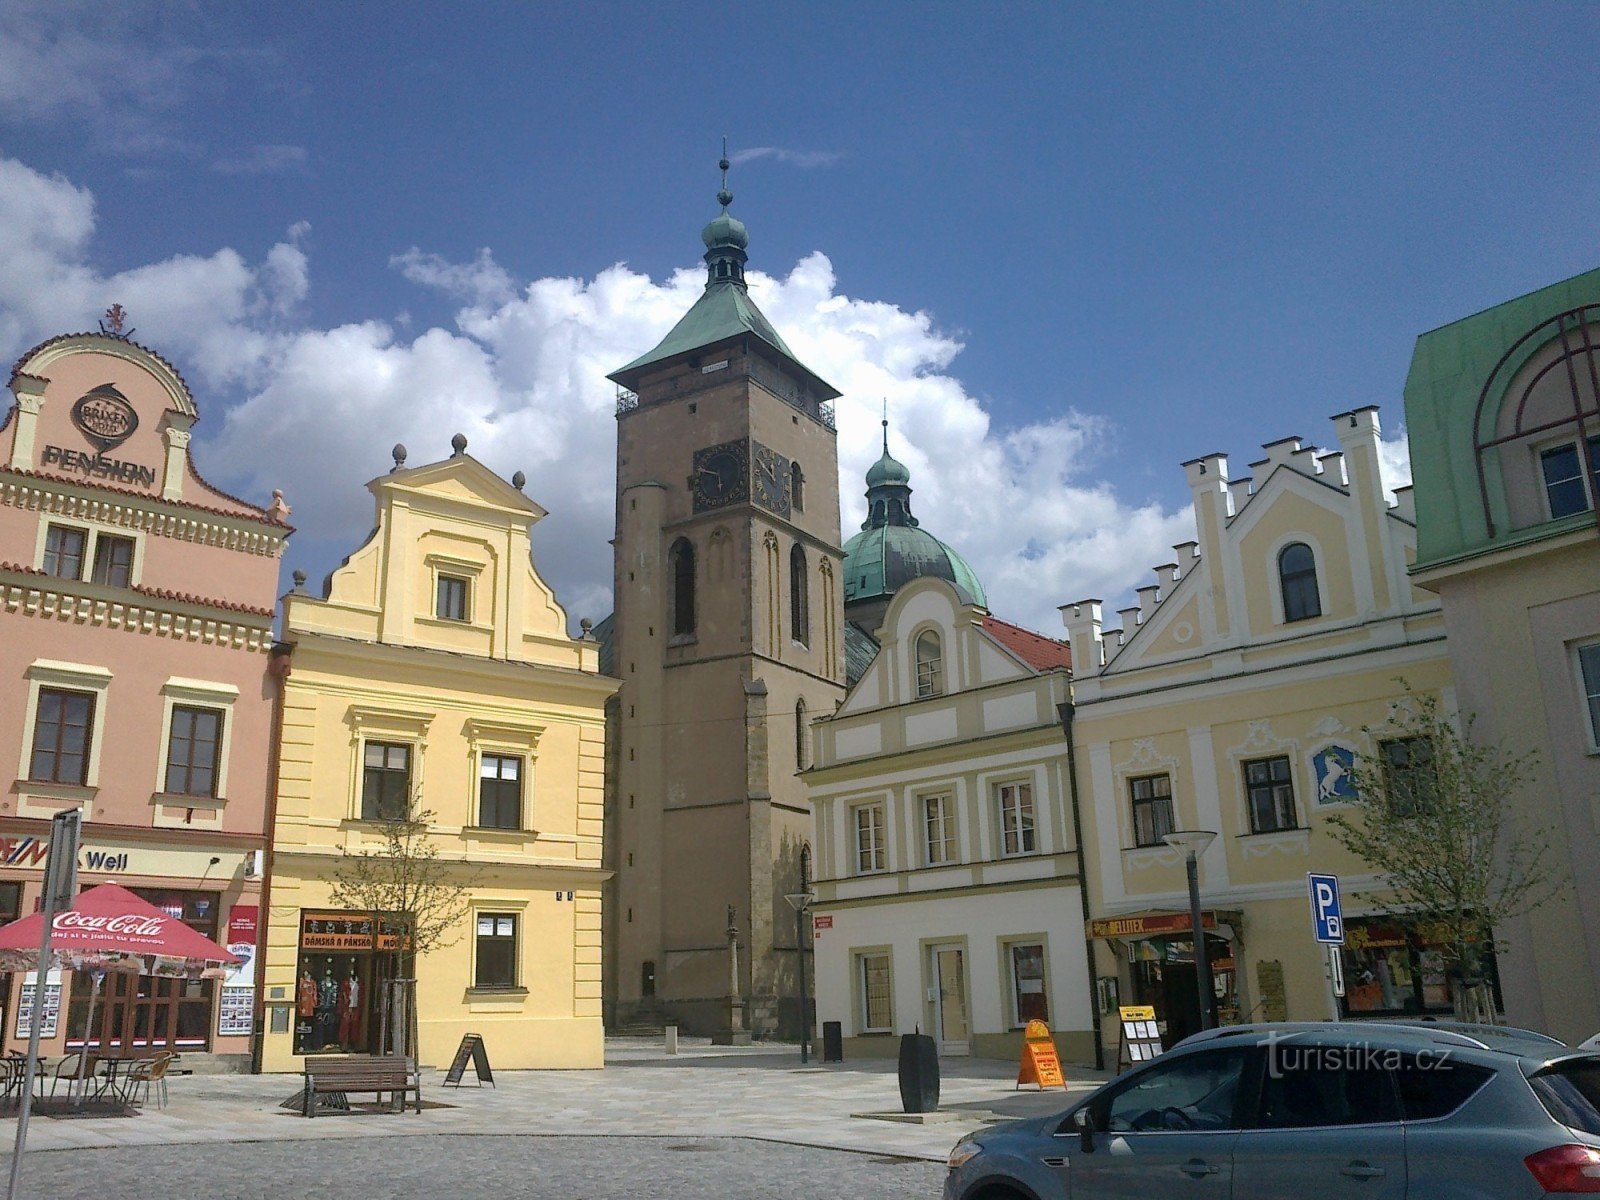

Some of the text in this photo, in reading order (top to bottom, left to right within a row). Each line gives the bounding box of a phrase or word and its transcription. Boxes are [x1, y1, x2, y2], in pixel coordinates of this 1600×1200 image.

[83, 406, 128, 424] BRIXEN
[43, 445, 155, 485] PENSION
[87, 851, 128, 870] Well
[1316, 883, 1333, 921] P
[52, 911, 167, 936] Coca-Cola
[129, 937, 166, 945] pravou
[336, 937, 342, 947] A
